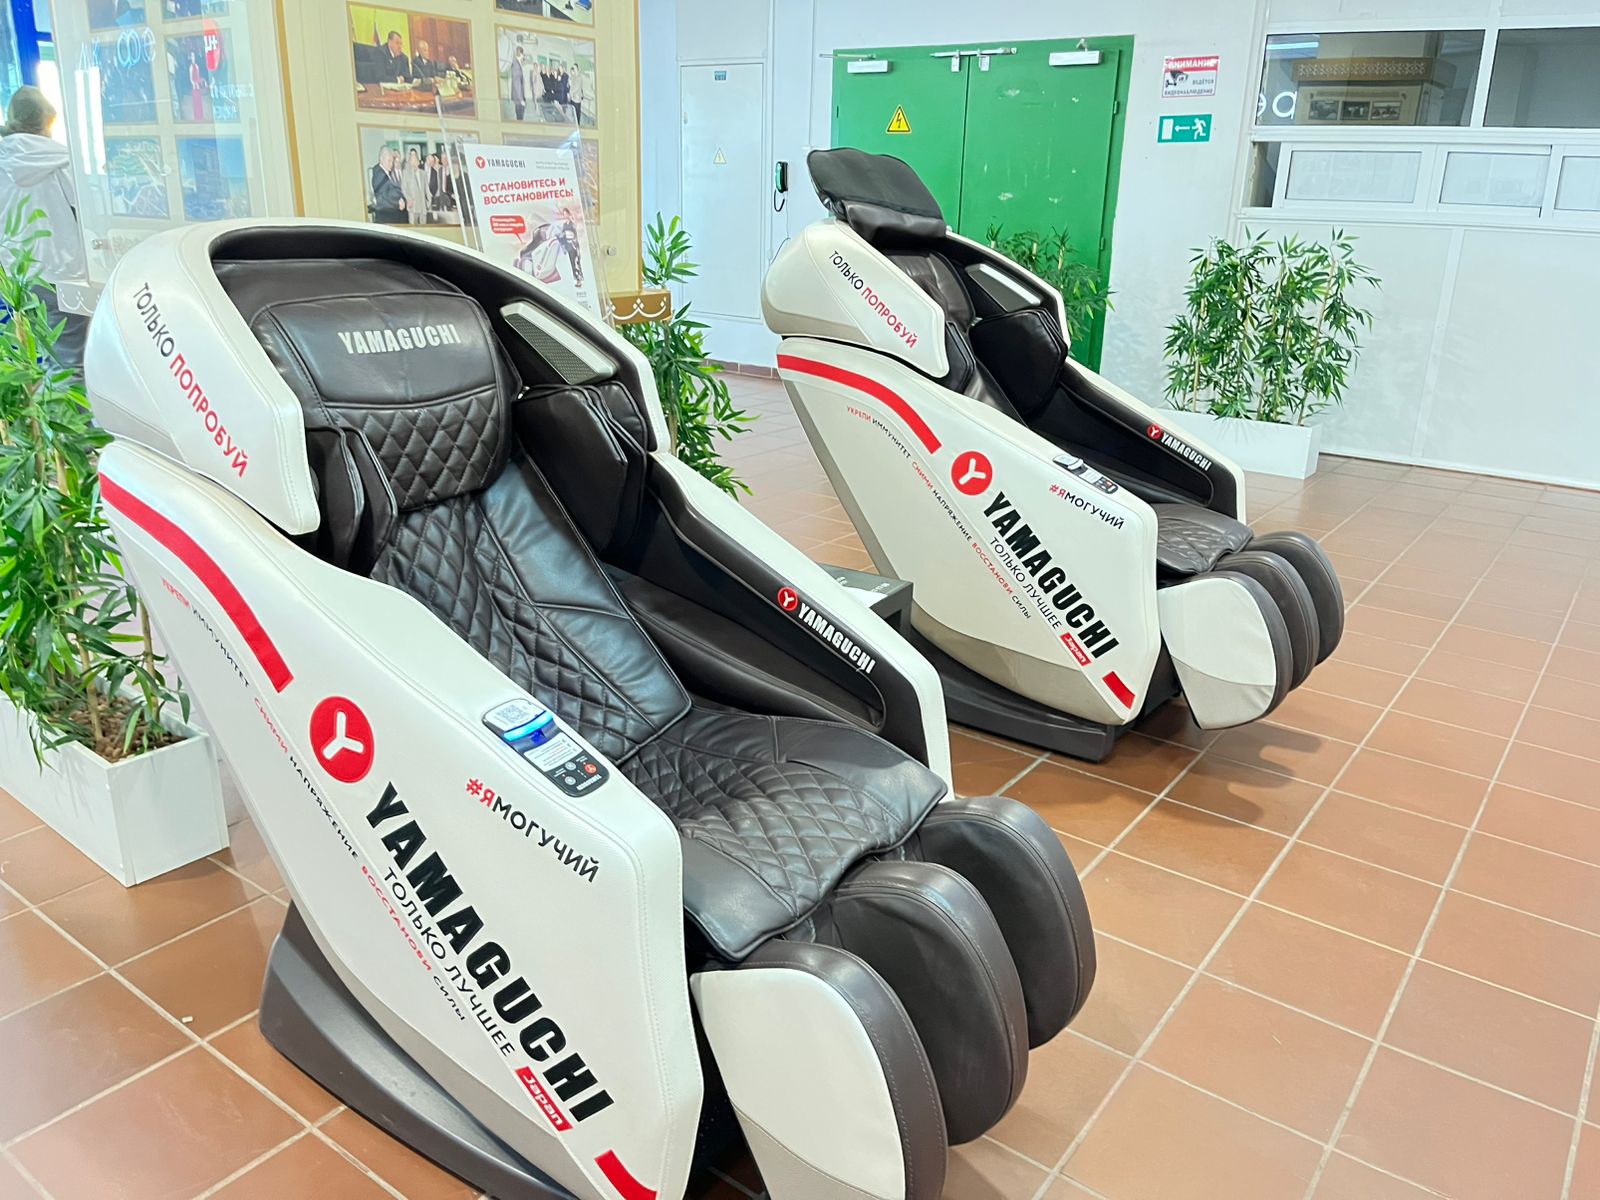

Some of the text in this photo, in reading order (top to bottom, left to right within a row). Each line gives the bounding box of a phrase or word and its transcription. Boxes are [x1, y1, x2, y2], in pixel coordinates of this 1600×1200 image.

[480, 178, 566, 193] ОСТАНОВИТЕСЬ И
[484, 188, 574, 205] ВОССТАНОВИТЕСЬ!
[487, 158, 526, 168] YAMAGUCHI
[338, 324, 461, 354] YAMAGUCHI
[829, 251, 918, 348] ТОЛЬКО ПОПРОБУЙ
[133, 282, 248, 478] ТОЛЬКО ПОПРОБУЙ
[1161, 433, 1212, 472] YAMAGUCHI
[872, 418, 912, 459] ИММУНИТЕТ
[911, 461, 934, 490] СНИМИ
[932, 489, 972, 541] НАПРЯЖЕНИЕ
[971, 542, 1013, 595] ВОССТАНОВИ
[1011, 595, 1032, 619] СИЛЫ
[1049, 484, 1124, 530] #ЯМОГУЧИЙ
[983, 491, 1120, 659] YAMAGUCHI
[990, 537, 1062, 630] ТОЛЬКО ЛУЧШЕЕ
[798, 602, 876, 674] YAMAGUCHI
[1062, 636, 1088, 664] Japan
[466, 778, 600, 883] #ЯМОГУЧИЙ
[289, 756, 360, 860] НАПРЯЖЕНИЕ
[361, 865, 432, 972] ВОССТАНОВИ
[433, 975, 465, 1021] СИЛЫ
[366, 781, 615, 1122] YAMAGUCHI
[384, 866, 516, 1057] ТОЛЬКО ЛУЧШЕЕ
[521, 1072, 565, 1127] Japan
